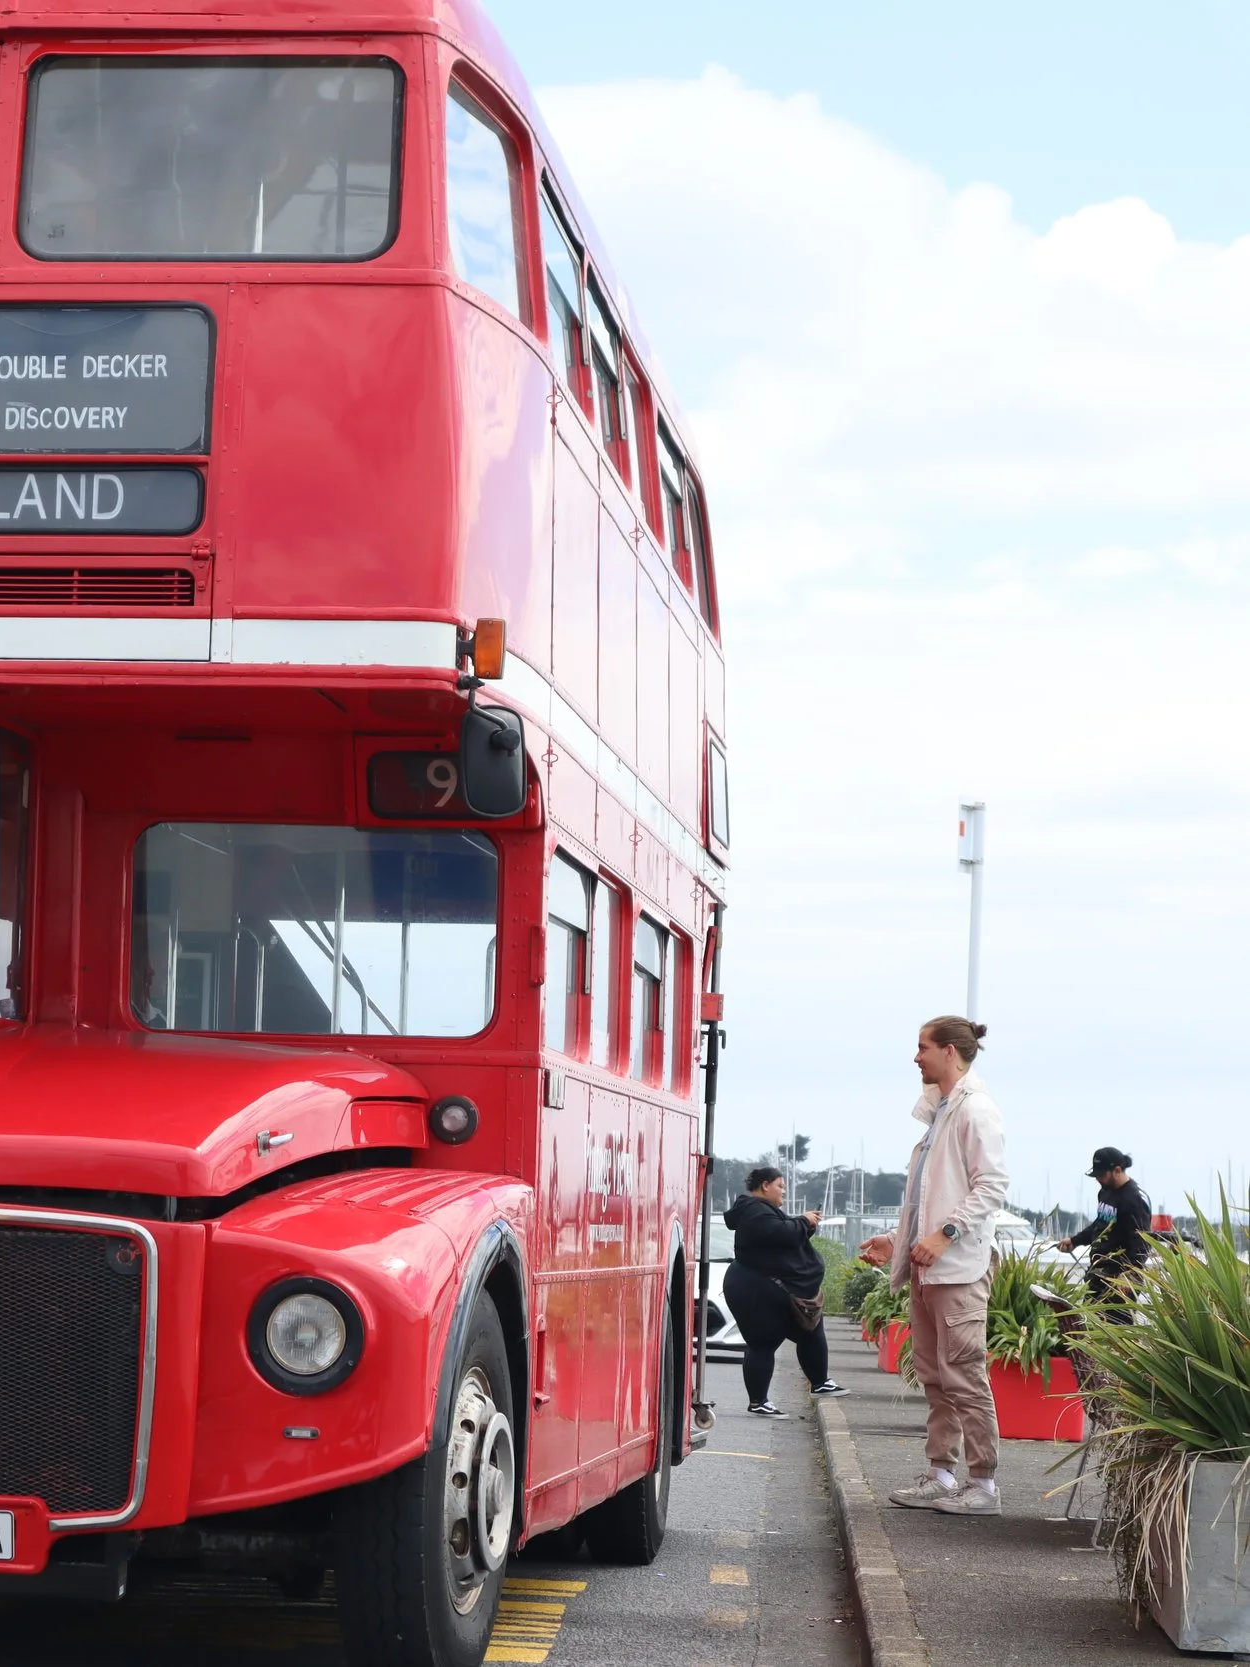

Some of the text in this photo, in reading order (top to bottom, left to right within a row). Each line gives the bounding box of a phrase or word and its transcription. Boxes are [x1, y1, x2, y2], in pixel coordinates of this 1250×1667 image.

[82, 353, 168, 379] DECKER
[4, 405, 128, 430] DISCOVERY
[426, 758, 458, 808] 9
